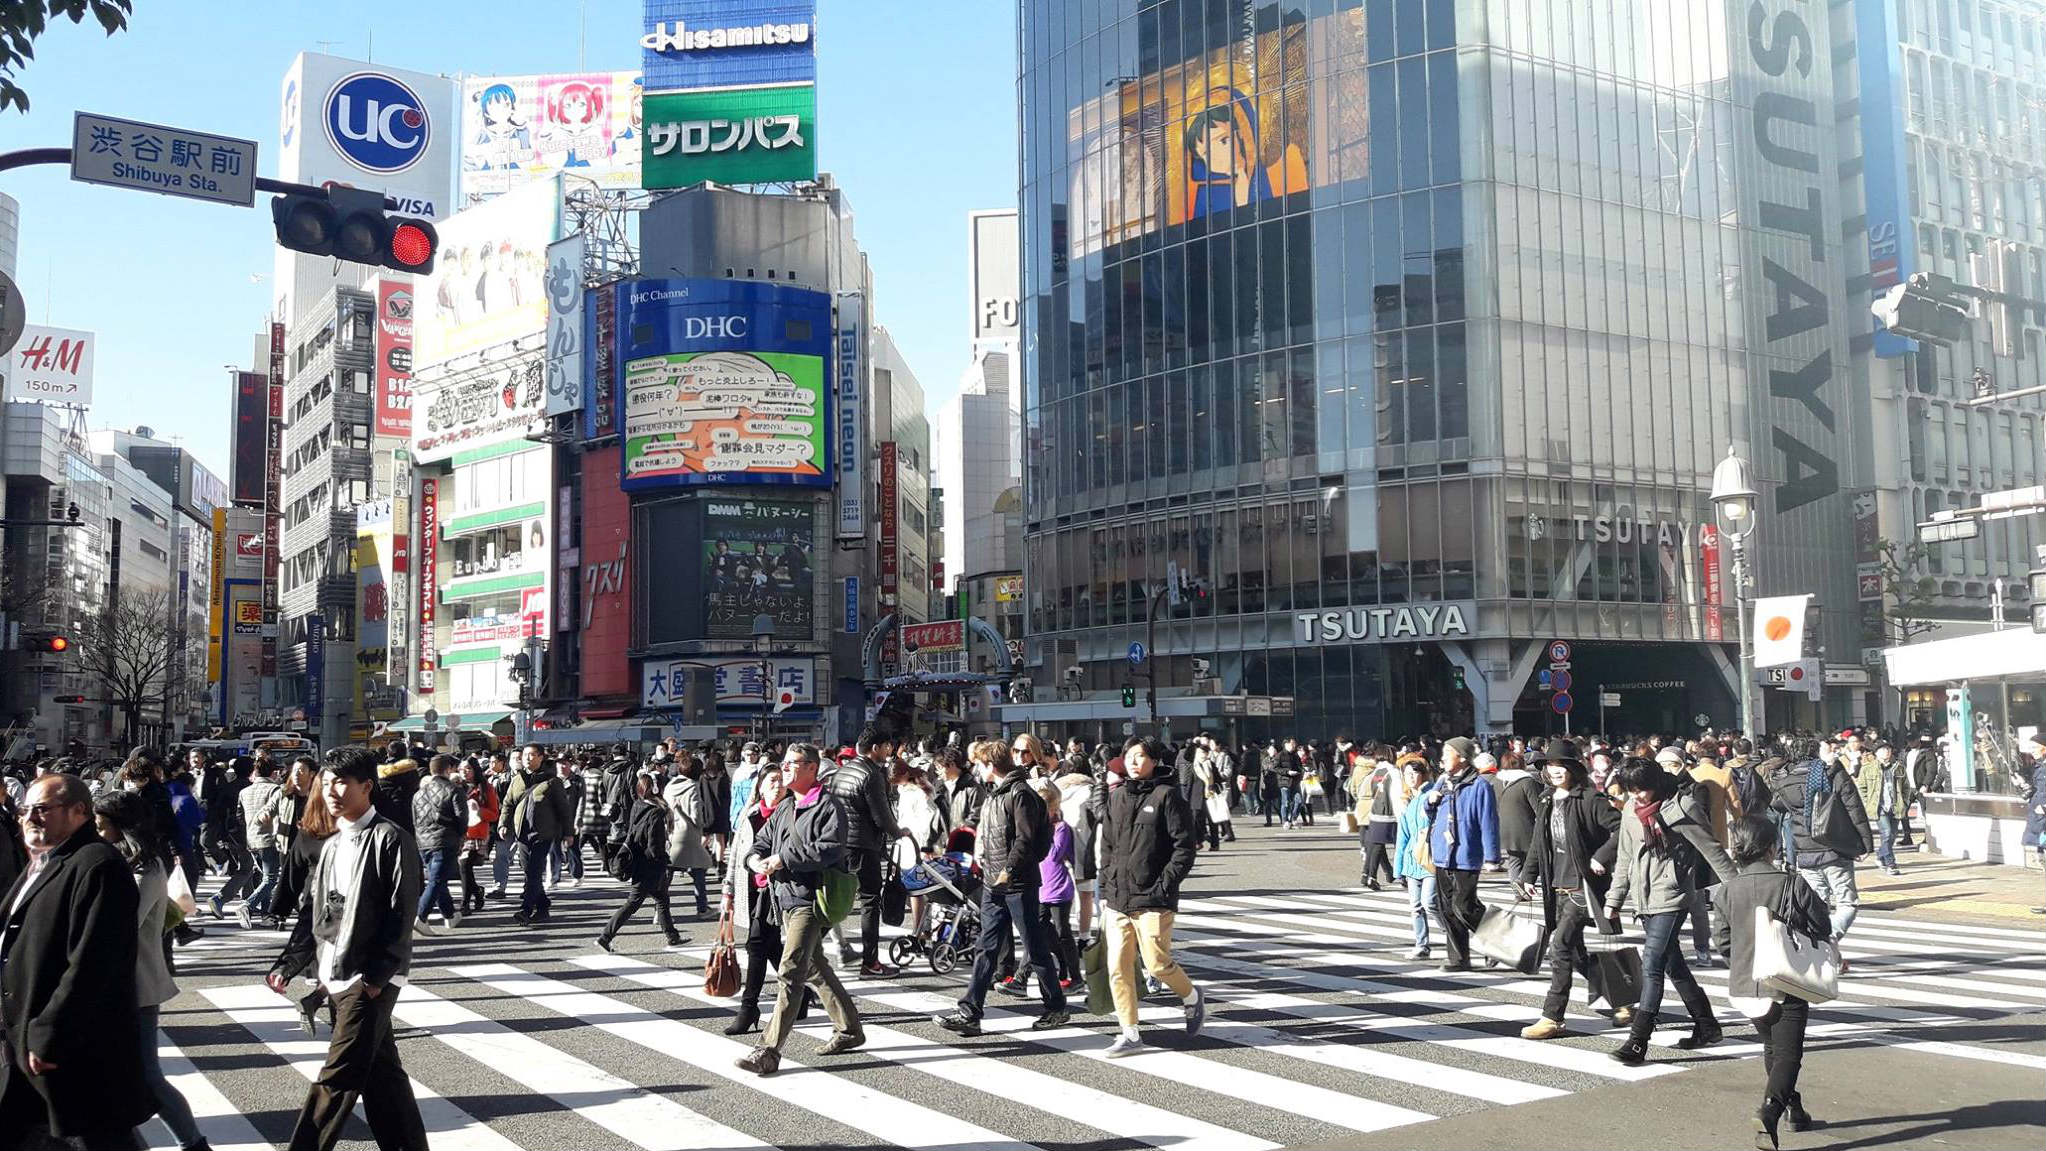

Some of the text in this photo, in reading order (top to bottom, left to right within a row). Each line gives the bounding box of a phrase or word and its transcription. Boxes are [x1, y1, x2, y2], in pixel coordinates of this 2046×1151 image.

[641, 21, 809, 53] Hisamitsu
[338, 93, 423, 150] UC
[647, 114, 804, 156] サロンパス
[89, 125, 242, 176] 渋谷駅前
[112, 161, 223, 193] Shibuya Sta.
[394, 196, 435, 217] VISA
[630, 287, 689, 305] DHC Channel
[685, 315, 747, 339] DHC
[21, 335, 85, 375] H&M
[26, 380, 64, 392] 150m
[842, 322, 858, 472] Taisei neon
[707, 473, 726, 482] DHC
[708, 504, 741, 516] DMM
[1298, 605, 1468, 642] TSUTAYA
[1653, 680, 1686, 688] COFFEE
